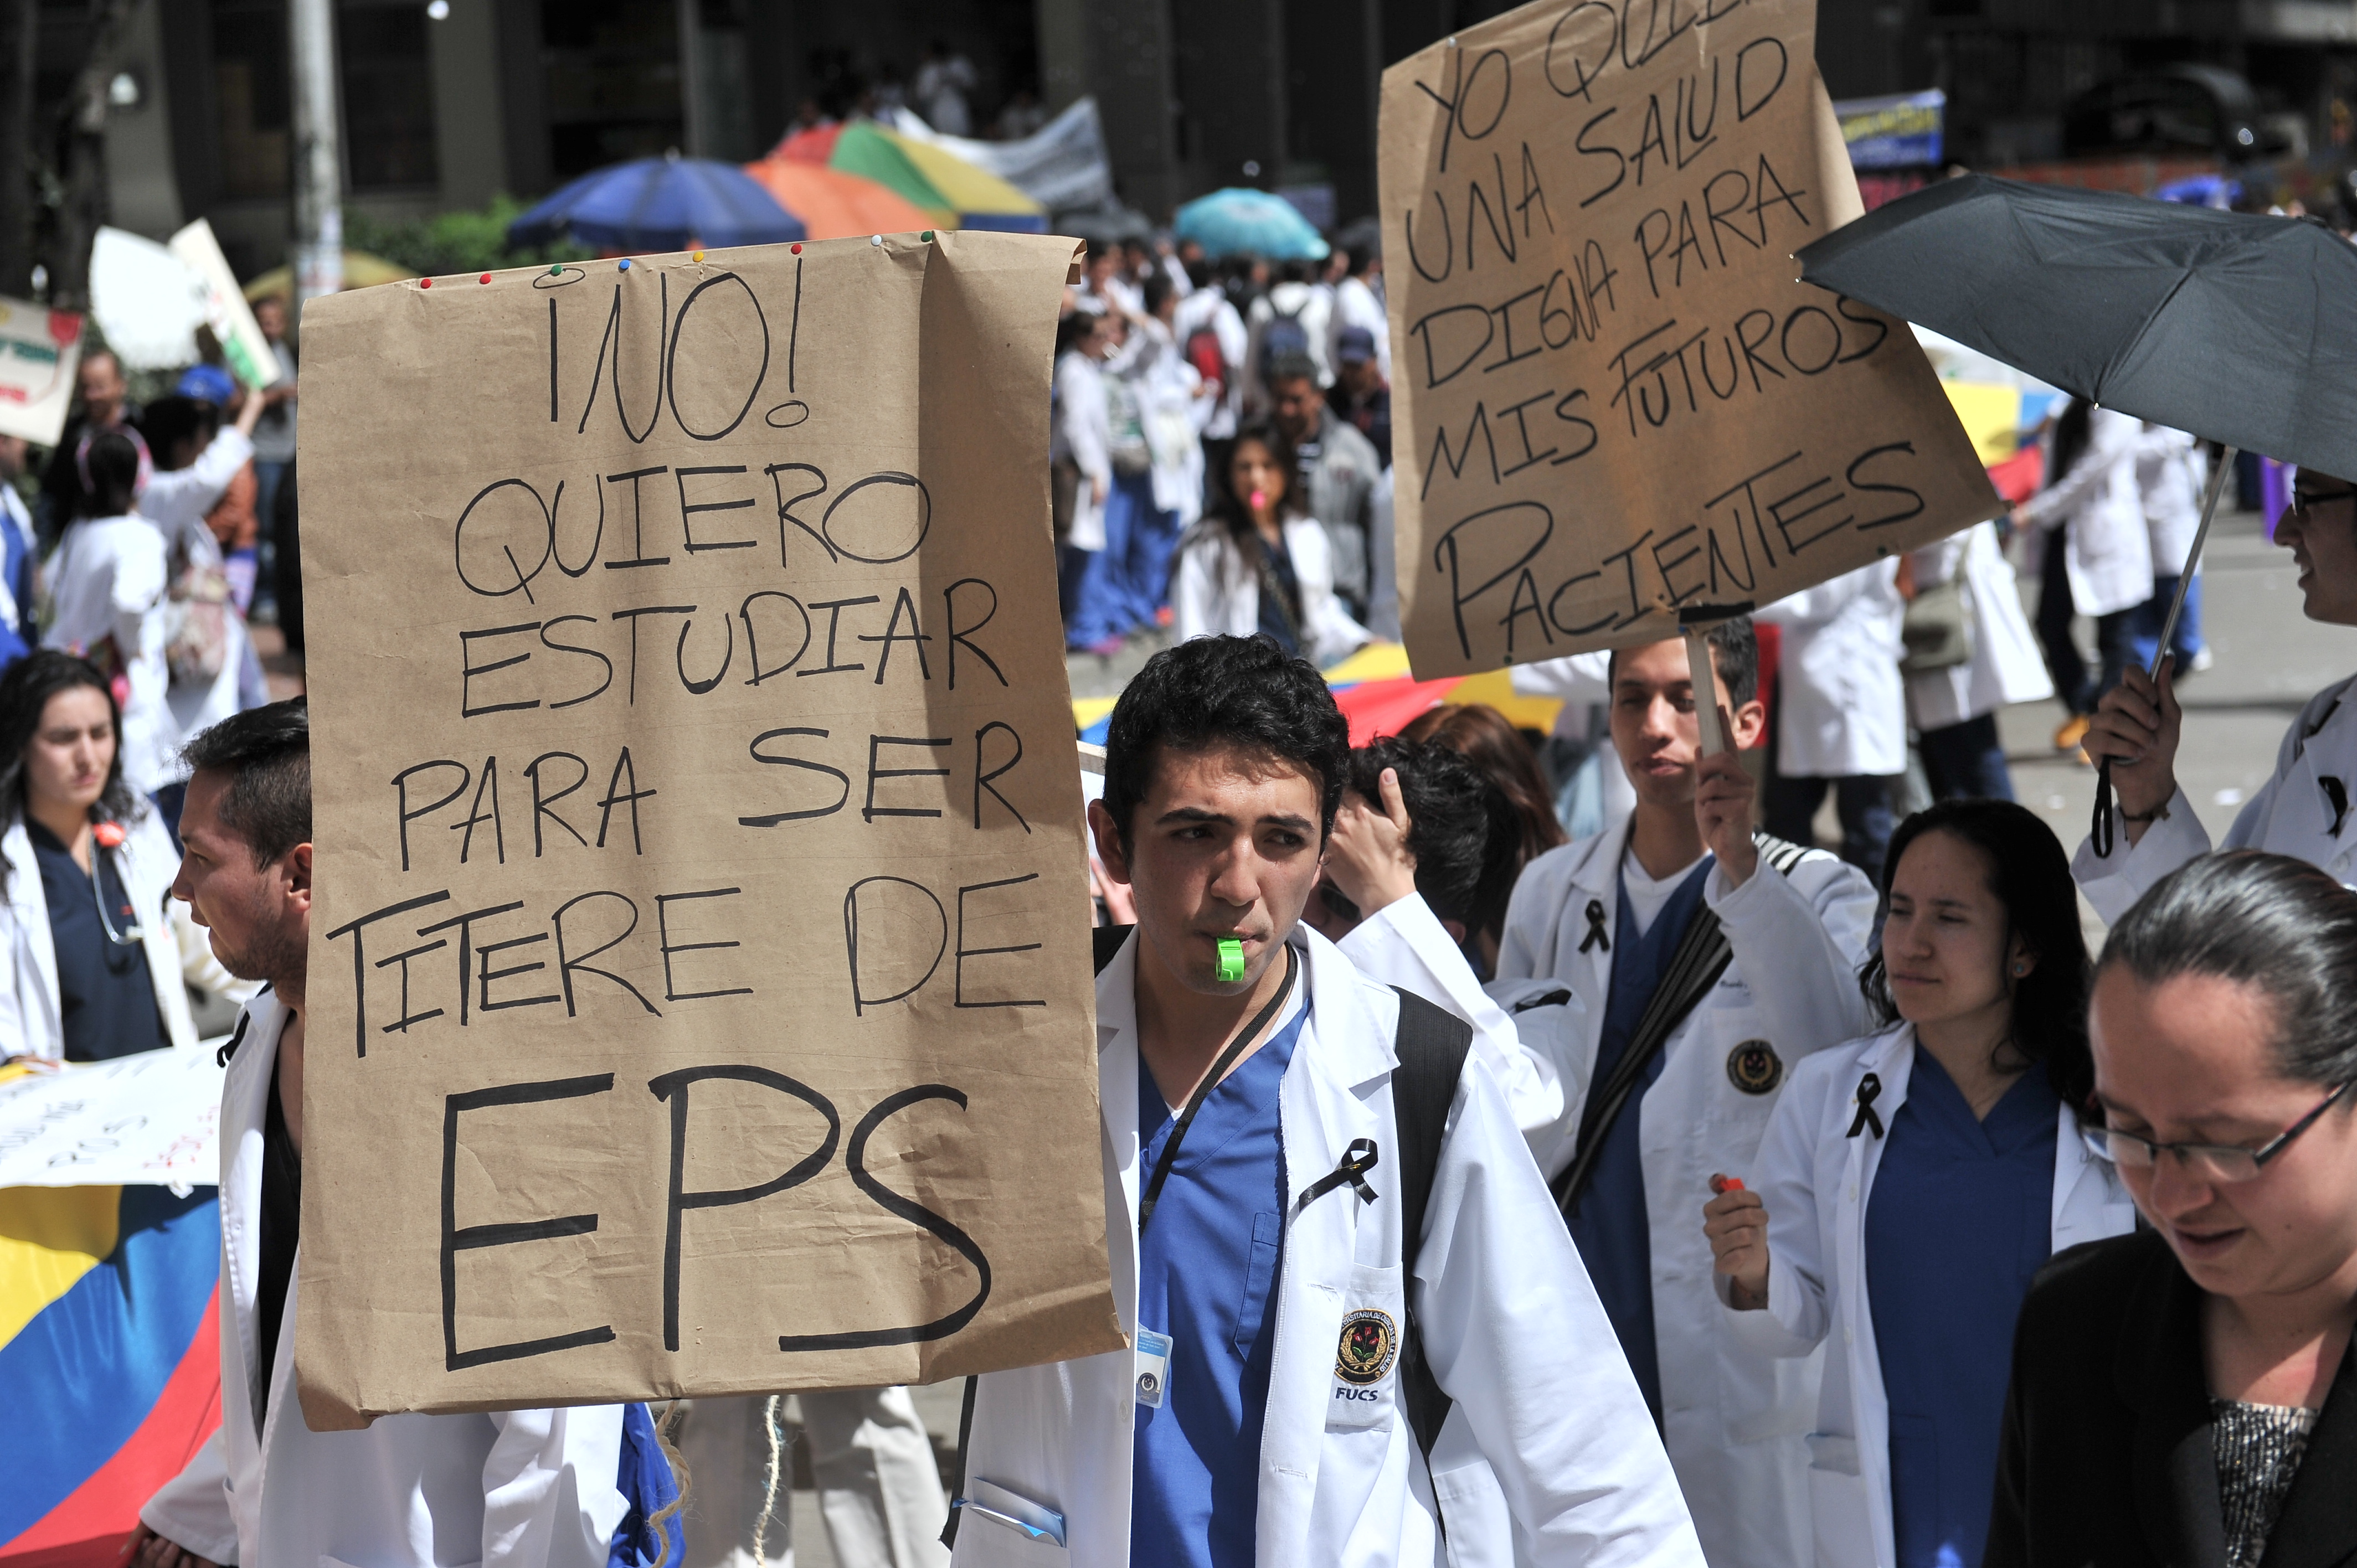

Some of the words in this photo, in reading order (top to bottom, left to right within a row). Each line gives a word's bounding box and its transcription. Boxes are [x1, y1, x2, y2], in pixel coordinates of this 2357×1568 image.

[1407, 142, 1554, 283] UNA
[1576, 38, 1787, 208] SALUD
[1414, 48, 1511, 173] YO
[533, 257, 809, 442] ¡NO!
[1410, 240, 1618, 389] DIGNA
[1634, 153, 1810, 298] PARA
[1421, 388, 1598, 502] MIS
[1608, 295, 1887, 438] FUTUROS
[455, 463, 932, 604] QUIERO
[1435, 441, 1925, 661] PACIENTES
[460, 577, 1008, 718] ESTUDIAR
[392, 747, 657, 871] PARA
[739, 721, 1031, 834] SER
[326, 889, 754, 1058] TITERE
[844, 873, 1047, 1017] DE
[442, 1065, 992, 1371] EPS
[1335, 1387, 1378, 1401] FUCS
